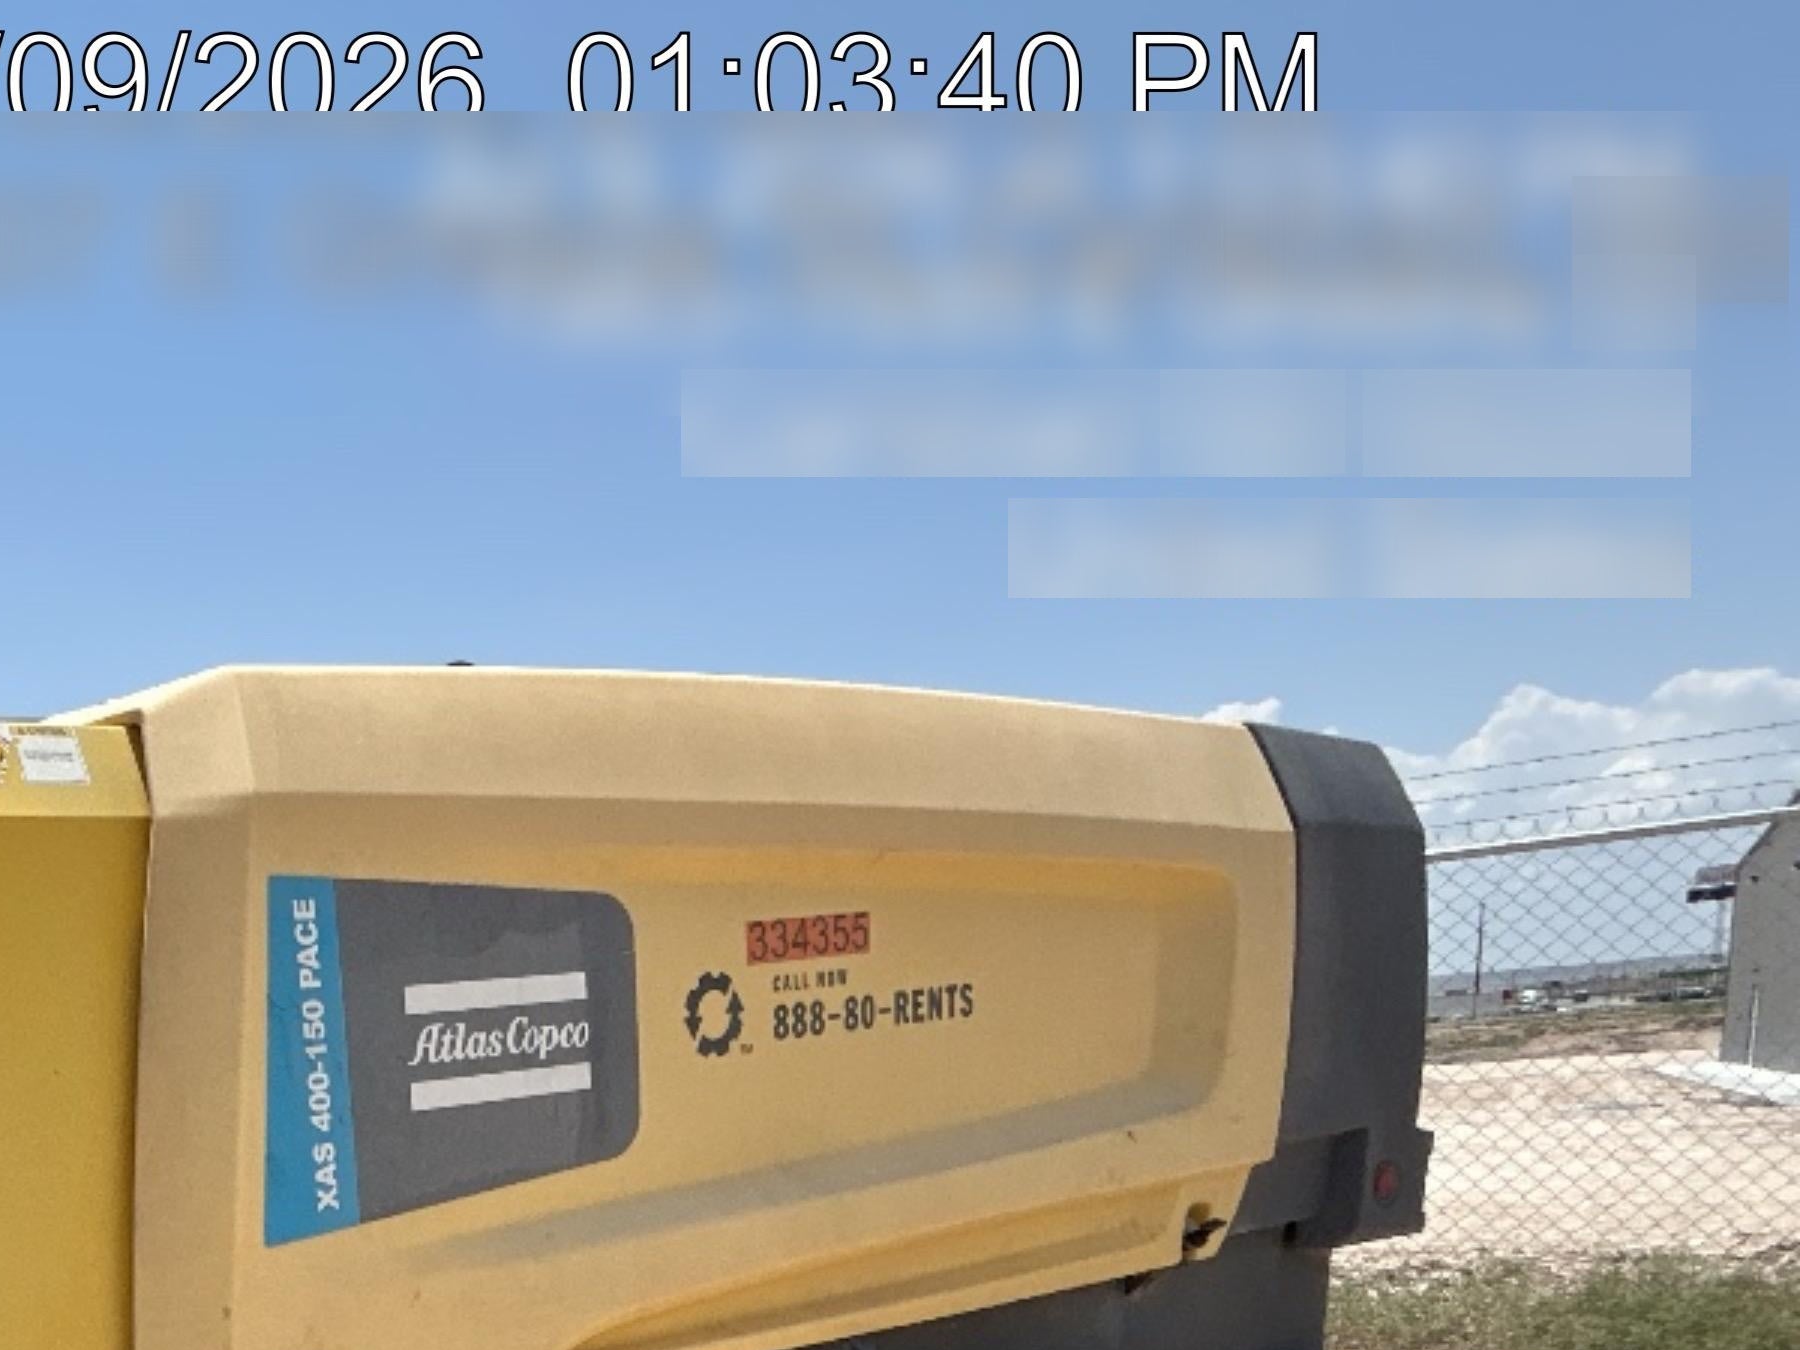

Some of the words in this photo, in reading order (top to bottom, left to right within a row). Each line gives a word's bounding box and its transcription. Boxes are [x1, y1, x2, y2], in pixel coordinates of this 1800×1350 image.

[293, 898, 322, 988] PACE
[750, 913, 869, 961] 334355
[773, 970, 810, 992] CALL
[816, 968, 847, 987] NOW
[773, 983, 973, 1039] 888-80-RENTS
[302, 999, 332, 1132] 400-150
[312, 1142, 340, 1212] XAS
